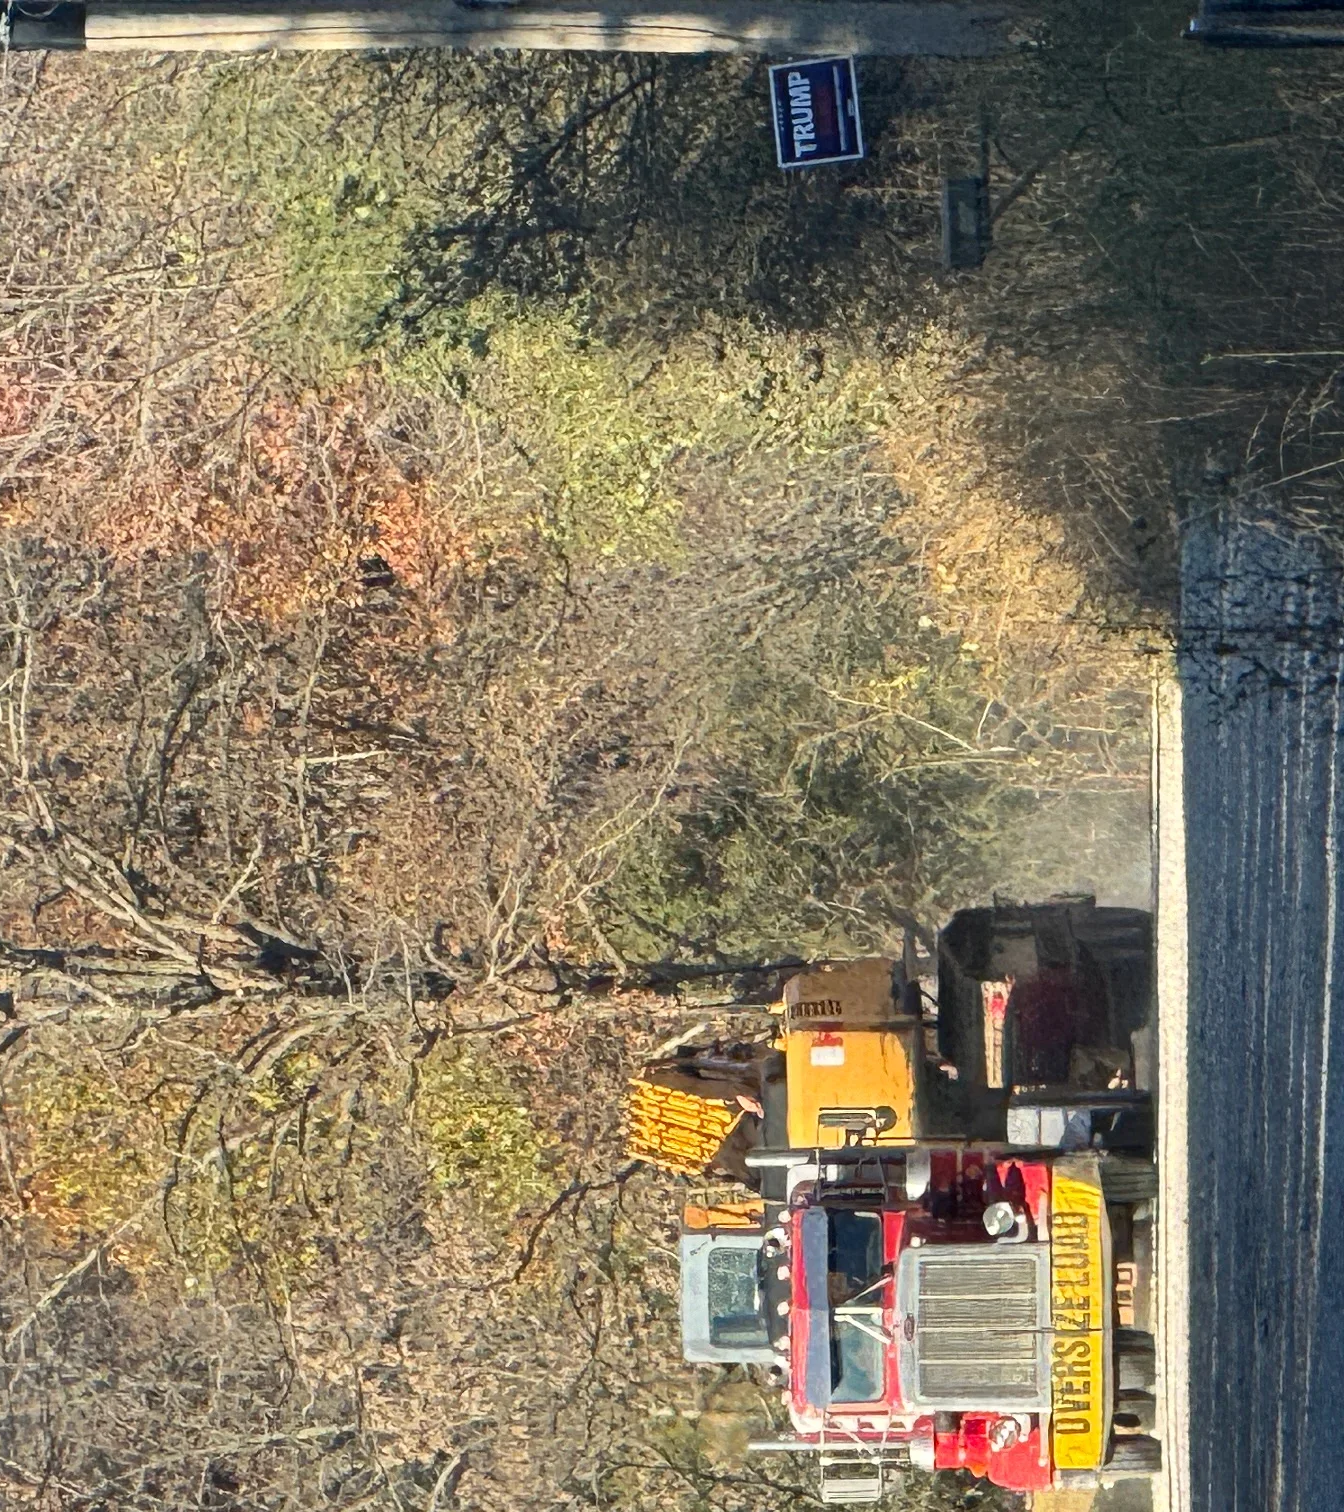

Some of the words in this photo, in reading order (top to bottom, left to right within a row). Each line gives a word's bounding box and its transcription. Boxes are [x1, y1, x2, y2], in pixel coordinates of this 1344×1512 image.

[788, 72, 817, 158] TRUMP
[1052, 1212, 1090, 1288] LOAD
[1052, 1296, 1091, 1435] OVERSIZE
